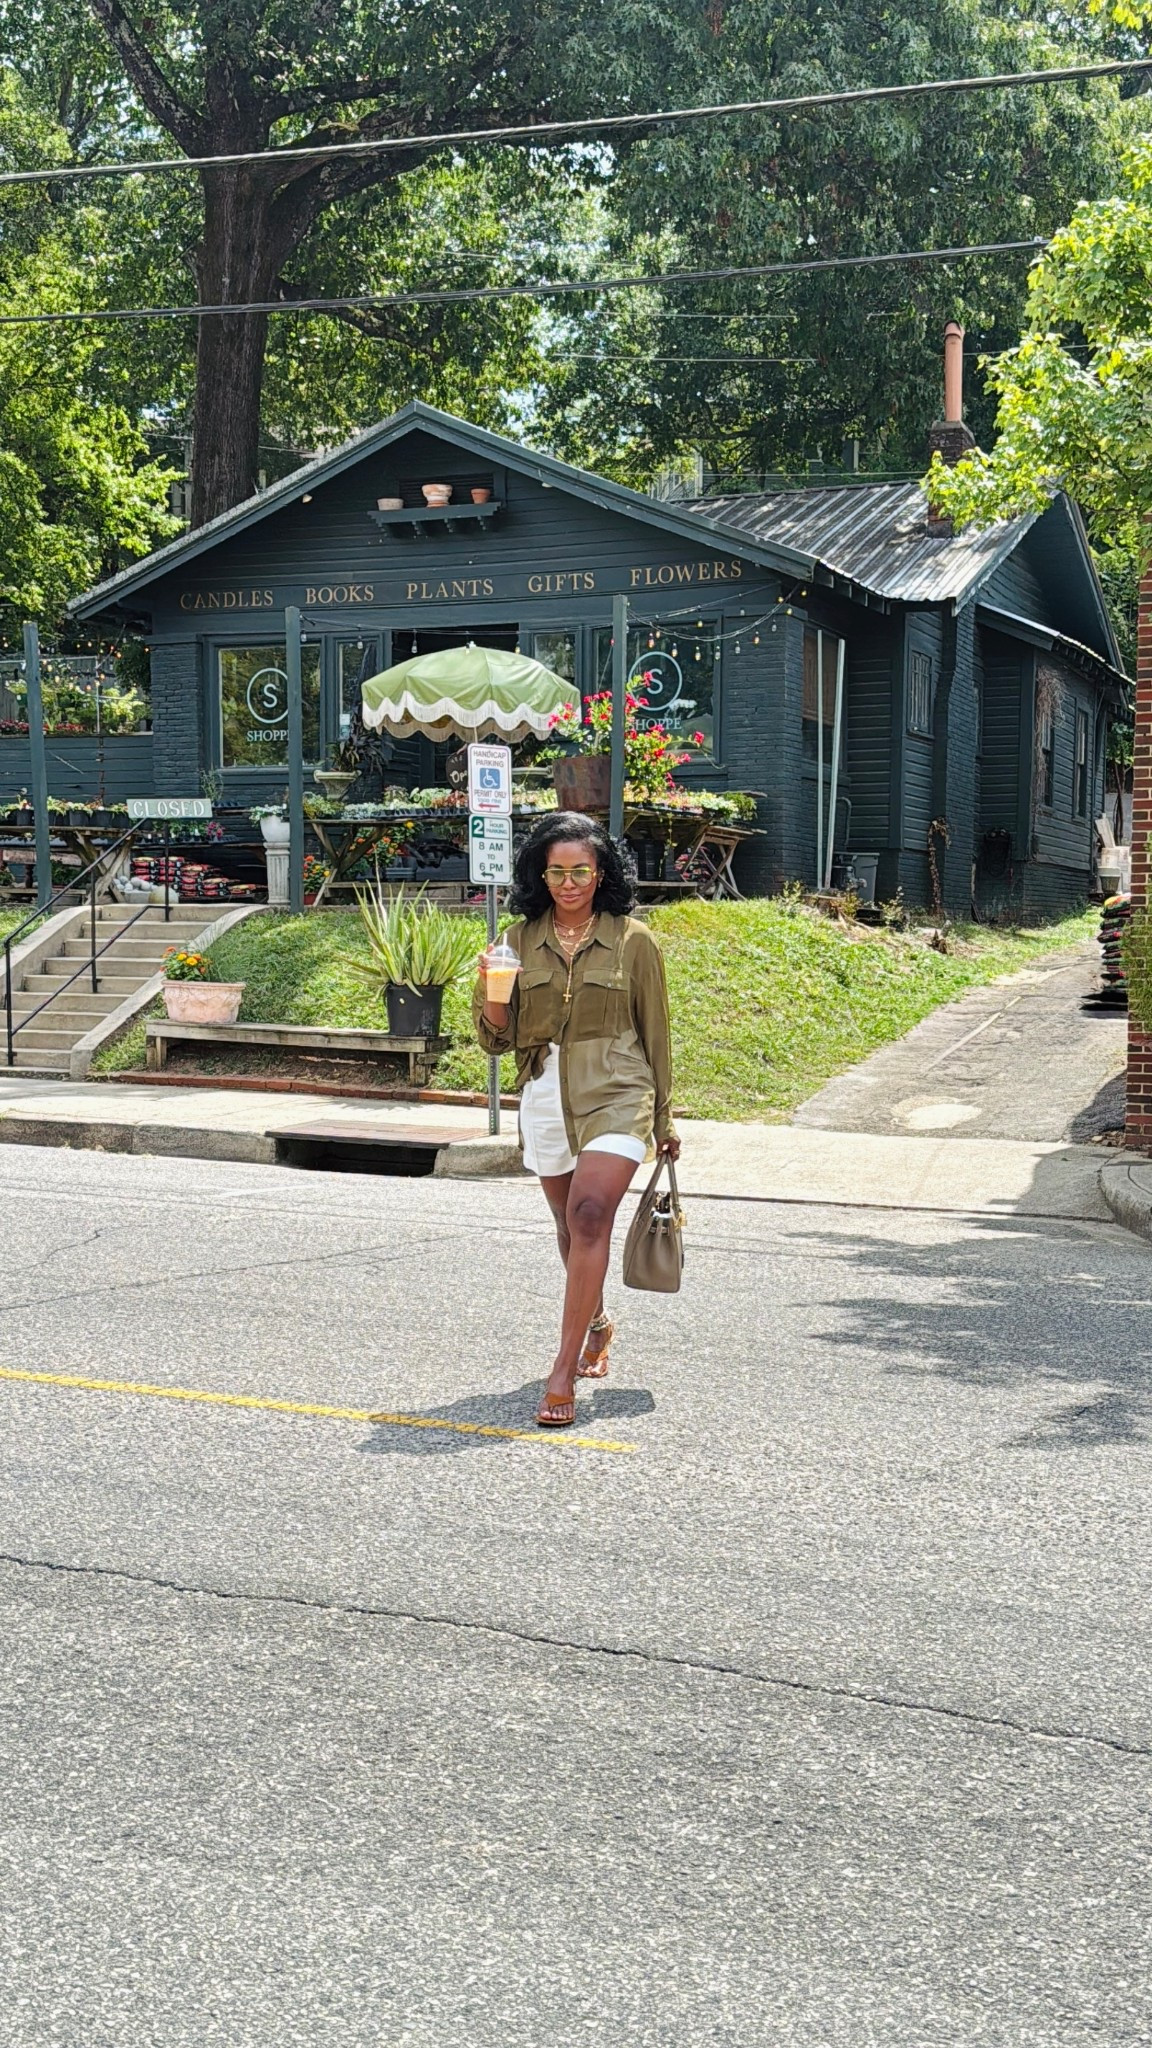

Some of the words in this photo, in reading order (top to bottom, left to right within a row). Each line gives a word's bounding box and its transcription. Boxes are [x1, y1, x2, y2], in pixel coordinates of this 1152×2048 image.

[180, 590, 274, 610] CANDLES
[305, 585, 375, 605] BOOKS
[406, 578, 495, 600] PLANTS
[528, 572, 596, 593] GIFTS
[630, 560, 742, 586] FLOWERS
[647, 668, 664, 695] S
[263, 683, 278, 708] S
[629, 717, 682, 731] HOPPE
[246, 729, 290, 742] SHOPP
[473, 750, 507, 759] HANDICAP
[475, 759, 504, 768] PARKING
[473, 789, 493, 798] PERMIT
[494, 790, 507, 799] ONLY
[133, 801, 205, 817] CLOSED
[473, 818, 484, 835] 2
[478, 841, 485, 851] 8
[489, 842, 504, 851] AM
[479, 862, 486, 871] 6
[489, 863, 504, 872] PM
